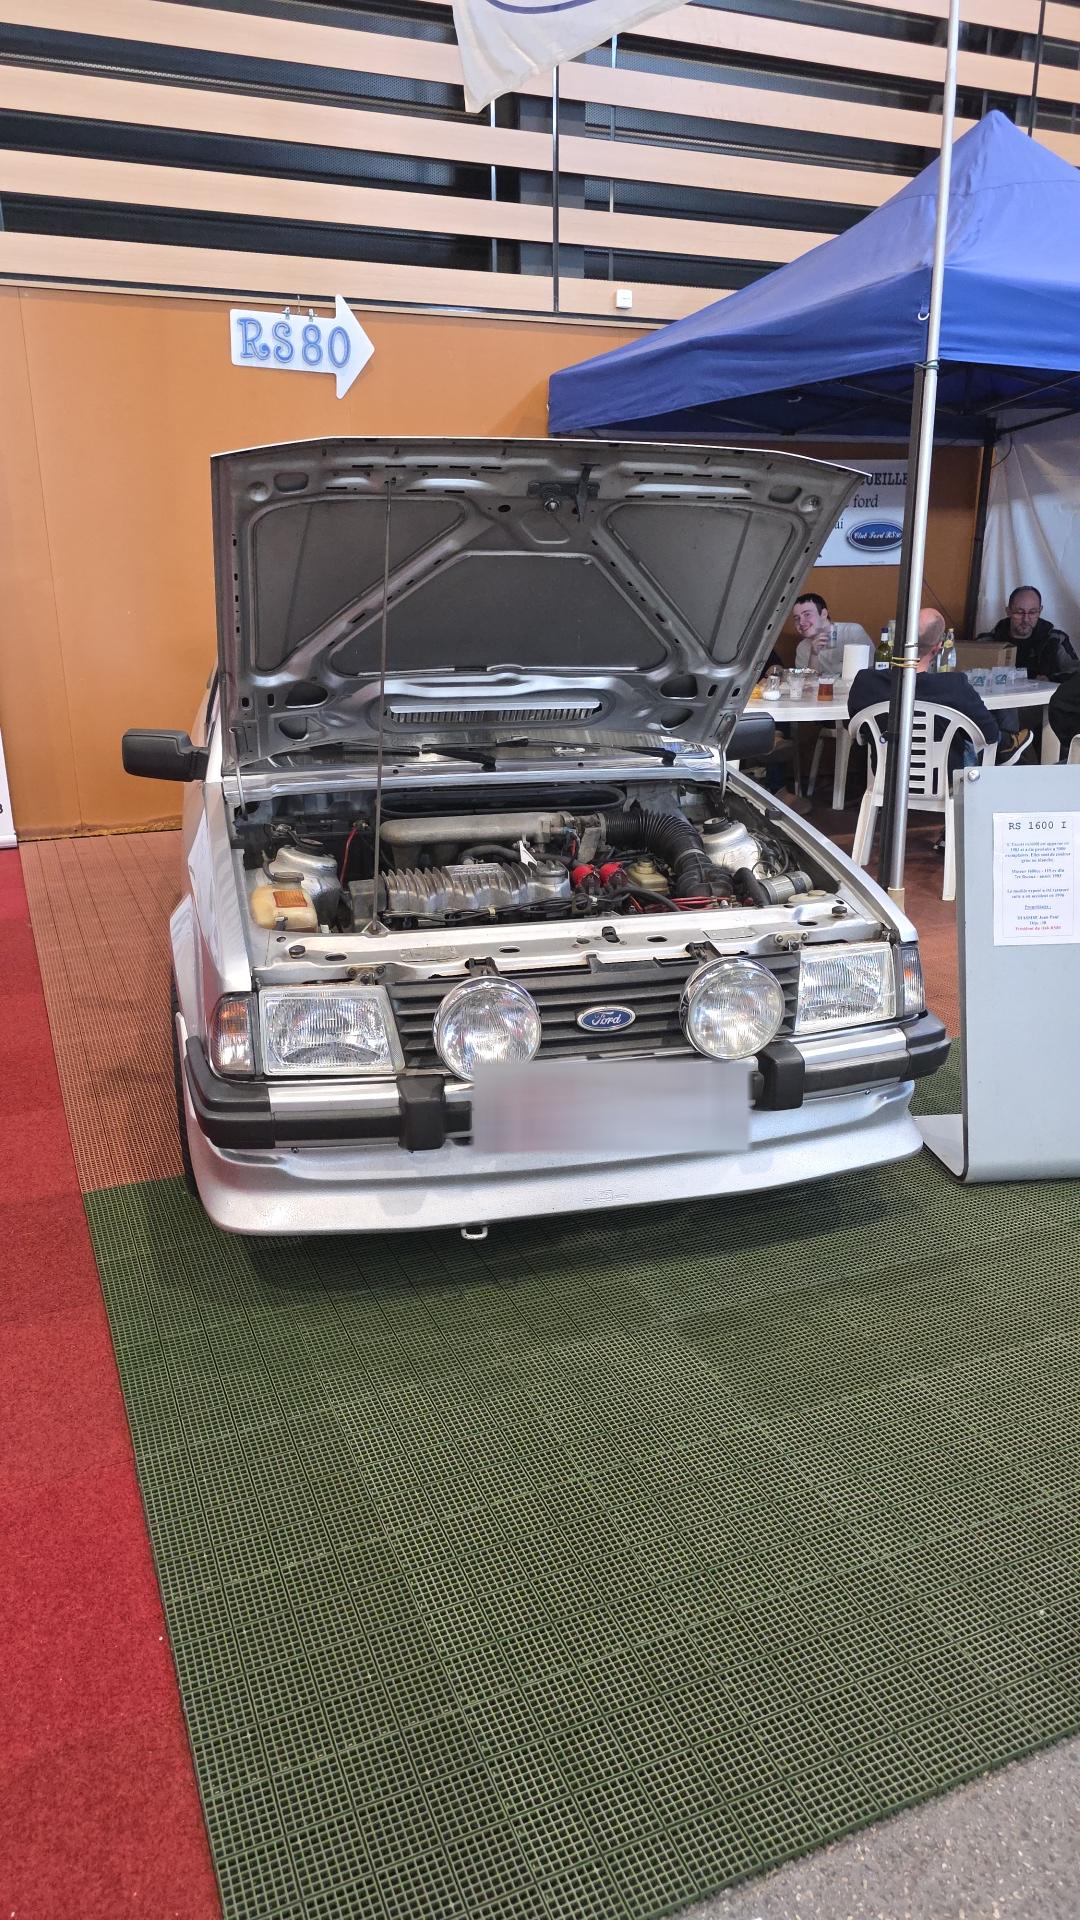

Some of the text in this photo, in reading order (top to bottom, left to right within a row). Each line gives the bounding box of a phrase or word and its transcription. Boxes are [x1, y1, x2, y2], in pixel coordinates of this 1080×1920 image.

[237, 317, 352, 369] RS80
[853, 493, 879, 508] ford
[1008, 821, 1067, 830] RS 1600 I
[591, 1011, 622, 1025] Ford
